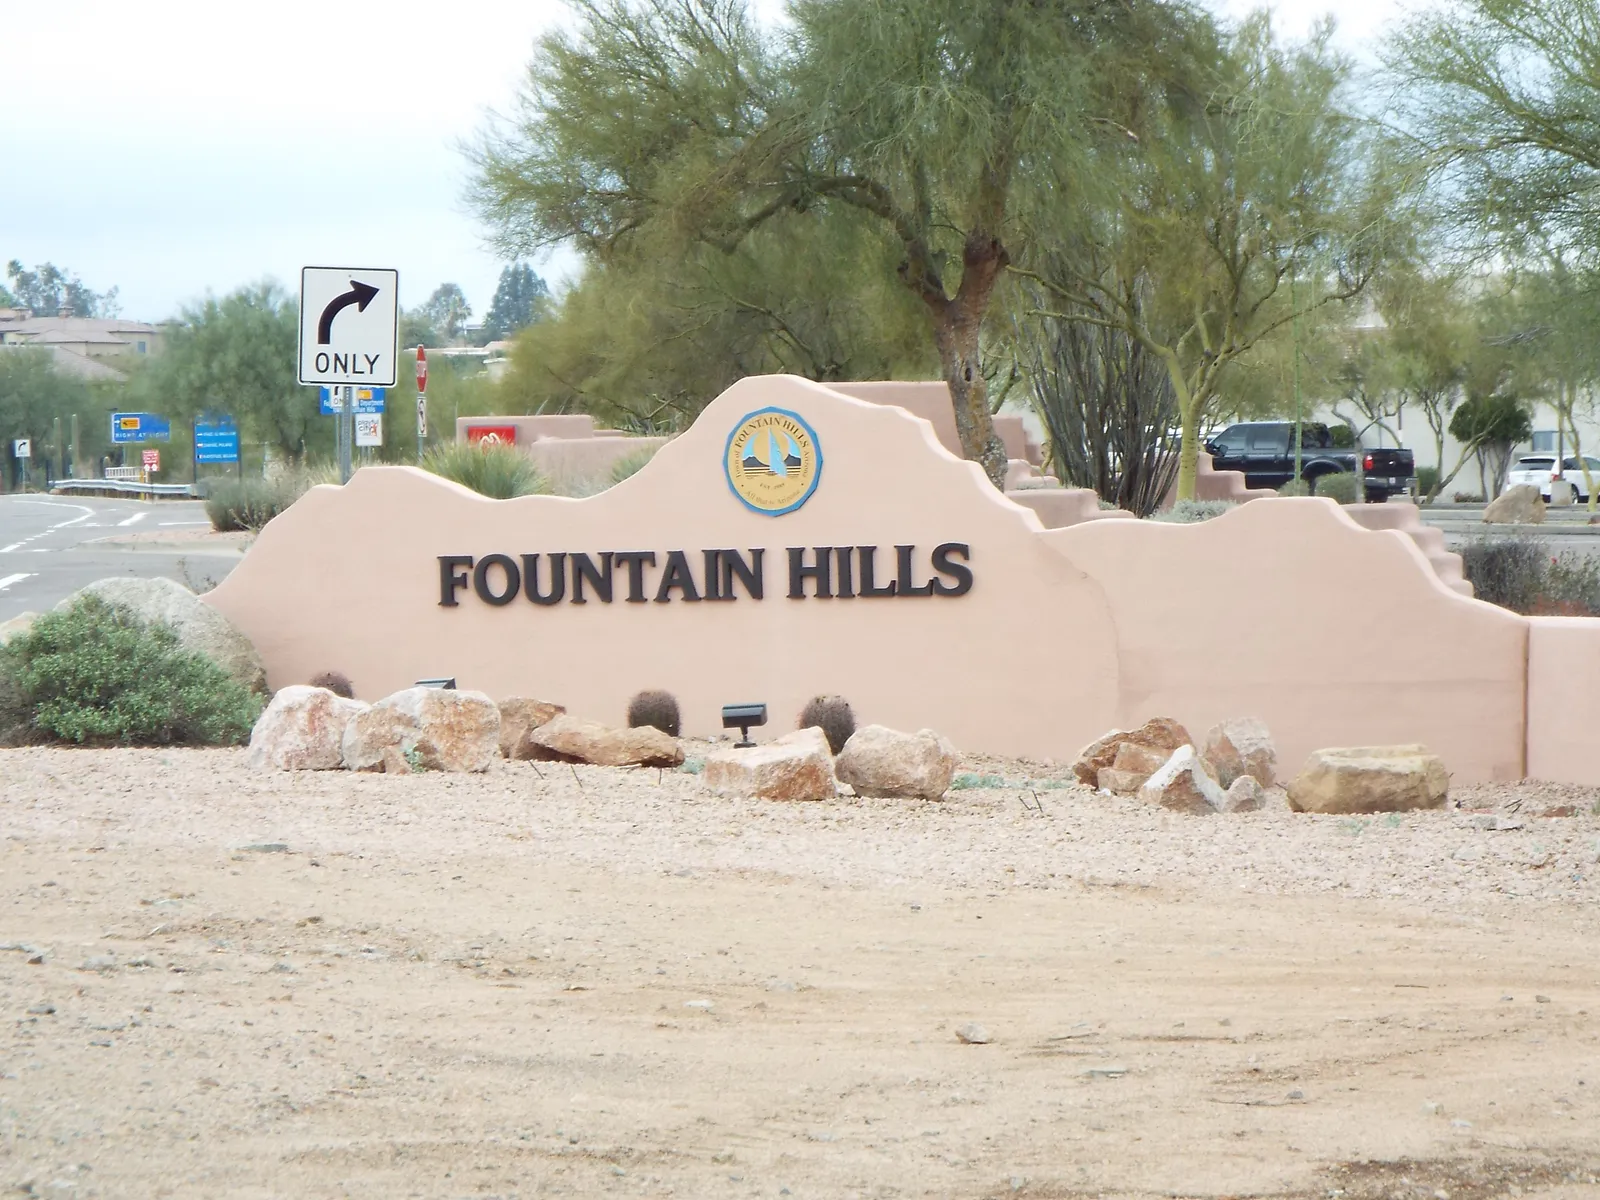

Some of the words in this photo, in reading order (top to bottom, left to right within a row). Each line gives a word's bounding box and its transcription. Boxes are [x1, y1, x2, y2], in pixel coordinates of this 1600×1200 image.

[315, 352, 380, 375] ONLY
[734, 417, 781, 448] FOUNTAIN
[782, 420, 809, 448] HILLS
[436, 547, 765, 607] FOUNTAIN
[785, 541, 974, 600] HILLS
